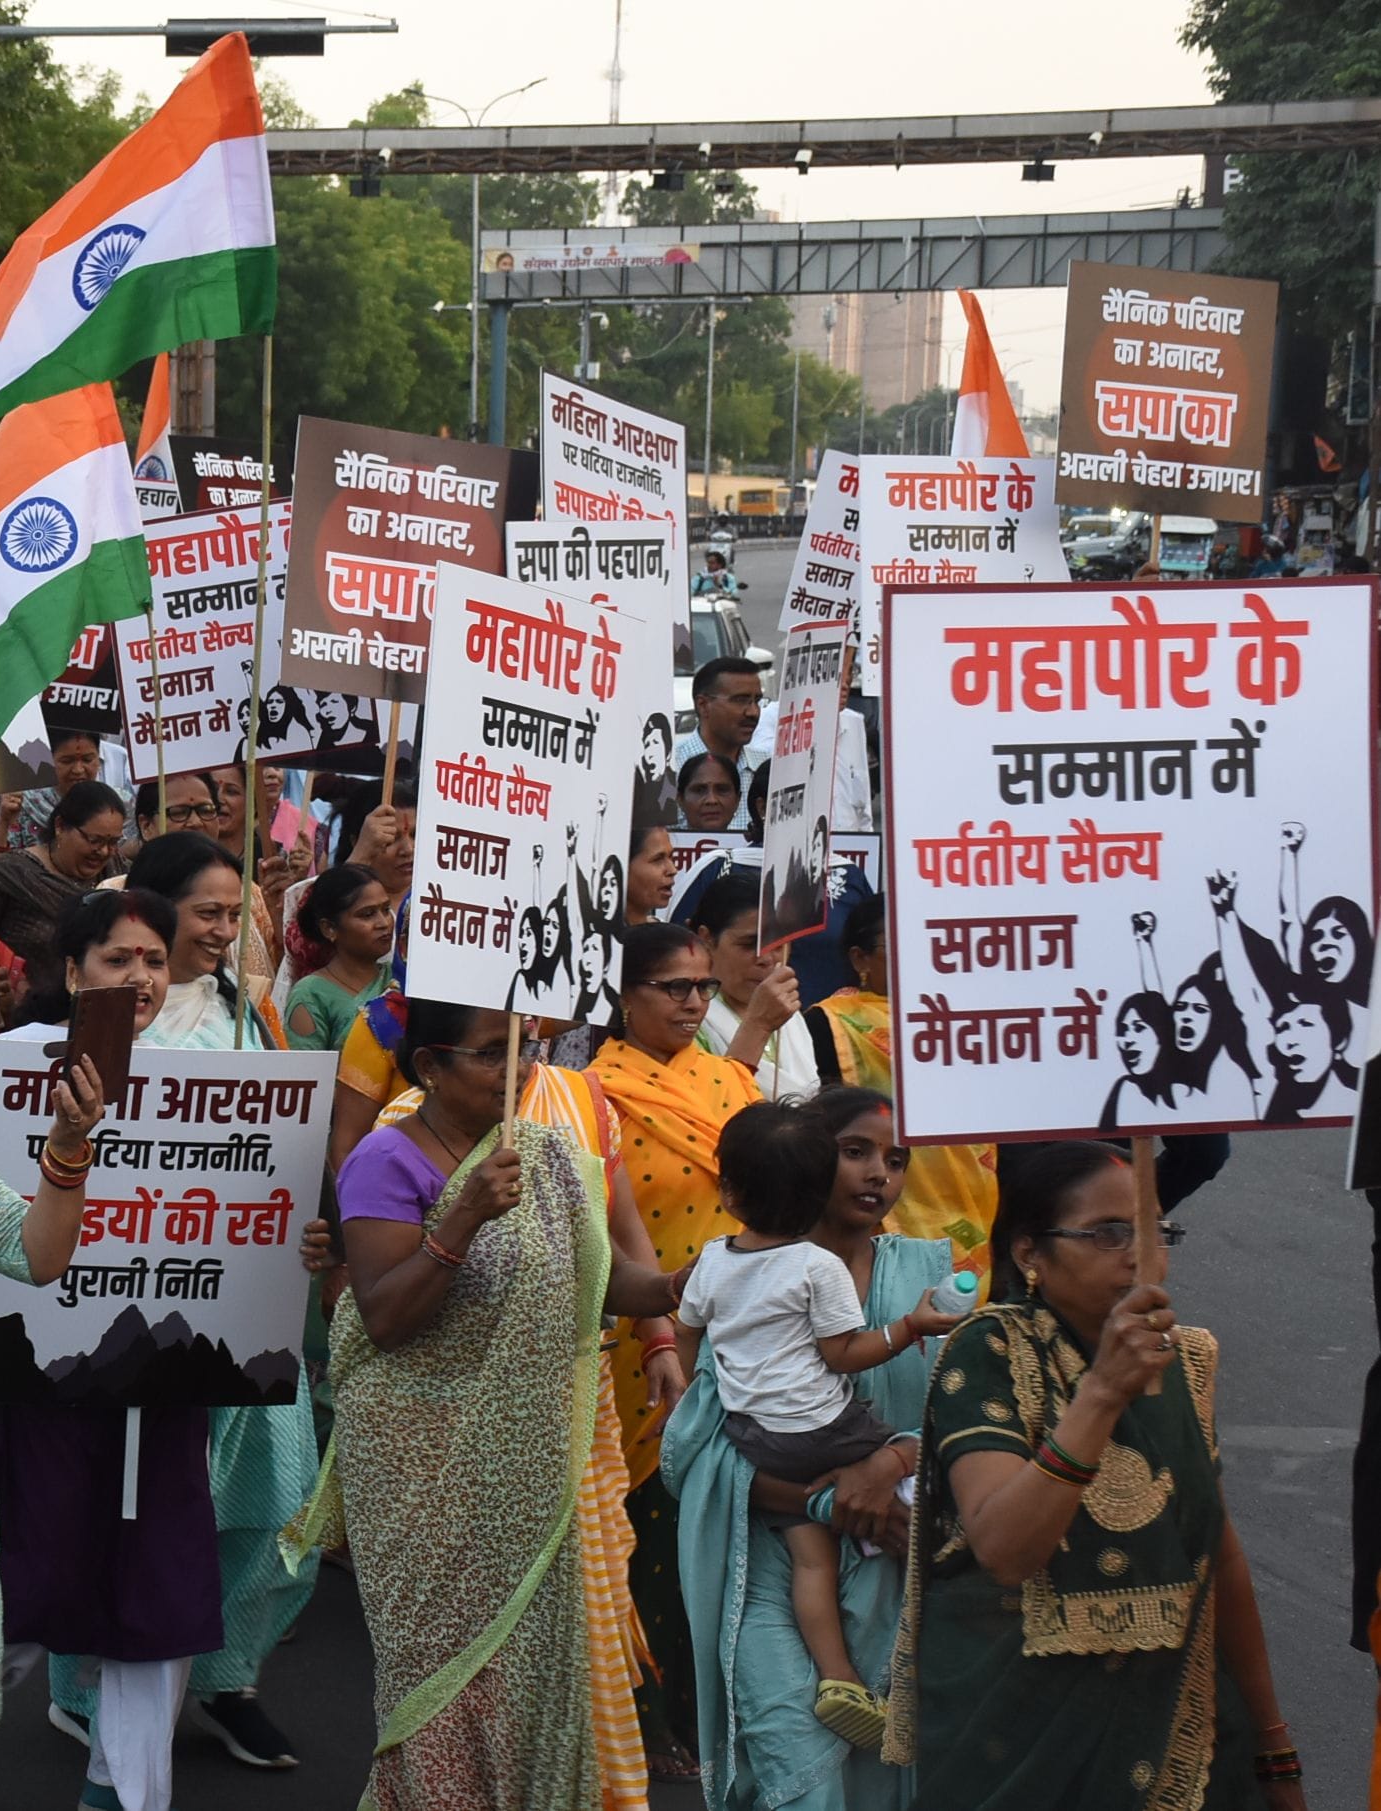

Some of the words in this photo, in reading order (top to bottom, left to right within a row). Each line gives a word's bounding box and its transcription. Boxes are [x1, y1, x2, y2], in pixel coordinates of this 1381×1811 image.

[1101, 287, 1171, 327] सैनिक
[1173, 296, 1244, 335] परिवार
[1113, 338, 1144, 367] का
[1147, 341, 1225, 379] अनादर,
[551, 391, 608, 444] महिला
[612, 417, 678, 469] आरक्षण
[1095, 380, 1177, 442] सपा
[1179, 391, 1238, 447] का
[193, 452, 233, 478] सैनिक
[334, 450, 413, 496] सैनिक
[416, 465, 500, 509] परिवार
[562, 441, 578, 465] पर
[580, 446, 613, 480] घटिया
[615, 461, 666, 500] राजनीति,
[885, 460, 1000, 512] महापौर
[1004, 462, 1036, 513] के
[1059, 449, 1128, 485] असली
[1129, 451, 1184, 488] चेहरा
[1185, 462, 1261, 496] उजागर।
[346, 506, 381, 538] का
[385, 511, 475, 556] अनादर,
[515, 539, 559, 583] सपा
[562, 526, 592, 581] की
[595, 538, 670, 586] पहचान,
[810, 531, 854, 560] पर्वतीय
[907, 523, 992, 553] सम्मान
[995, 517, 1020, 553] में
[326, 551, 419, 622] सपा
[805, 561, 855, 591] समाज
[790, 587, 835, 619] मैदान
[835, 597, 856, 620] में
[202, 620, 254, 650] सैन्य
[290, 628, 363, 666] असली
[367, 631, 426, 674] चेहरा
[465, 598, 587, 696] महापौर
[591, 614, 622, 703] के
[943, 595, 1218, 713] महापौर
[1229, 593, 1309, 706] के
[137, 666, 215, 703] समाज
[131, 712, 201, 746] मैदान
[205, 698, 233, 733] में
[482, 696, 573, 764] सम्मान
[574, 707, 600, 772] में
[435, 752, 503, 812] पर्वतीय
[506, 764, 552, 822] सैन्य
[993, 738, 1197, 806] सम्मान
[1206, 717, 1268, 798] में
[436, 824, 511, 881] समाज
[912, 820, 1050, 888] पर्वतीय
[1057, 818, 1163, 883] सैन्य
[420, 882, 489, 950] मैदान
[492, 895, 519, 955] में
[925, 914, 1078, 976] समाज
[907, 992, 1046, 1067] मैदान
[1052, 988, 1107, 1061] में
[157, 1076, 318, 1125] आरक्षण
[159, 1134, 275, 1178] राजनीति,
[164, 1189, 220, 1245] की
[226, 1189, 294, 1245] रही
[56, 1258, 149, 1308] पुरानी
[155, 1258, 224, 1301] निति
